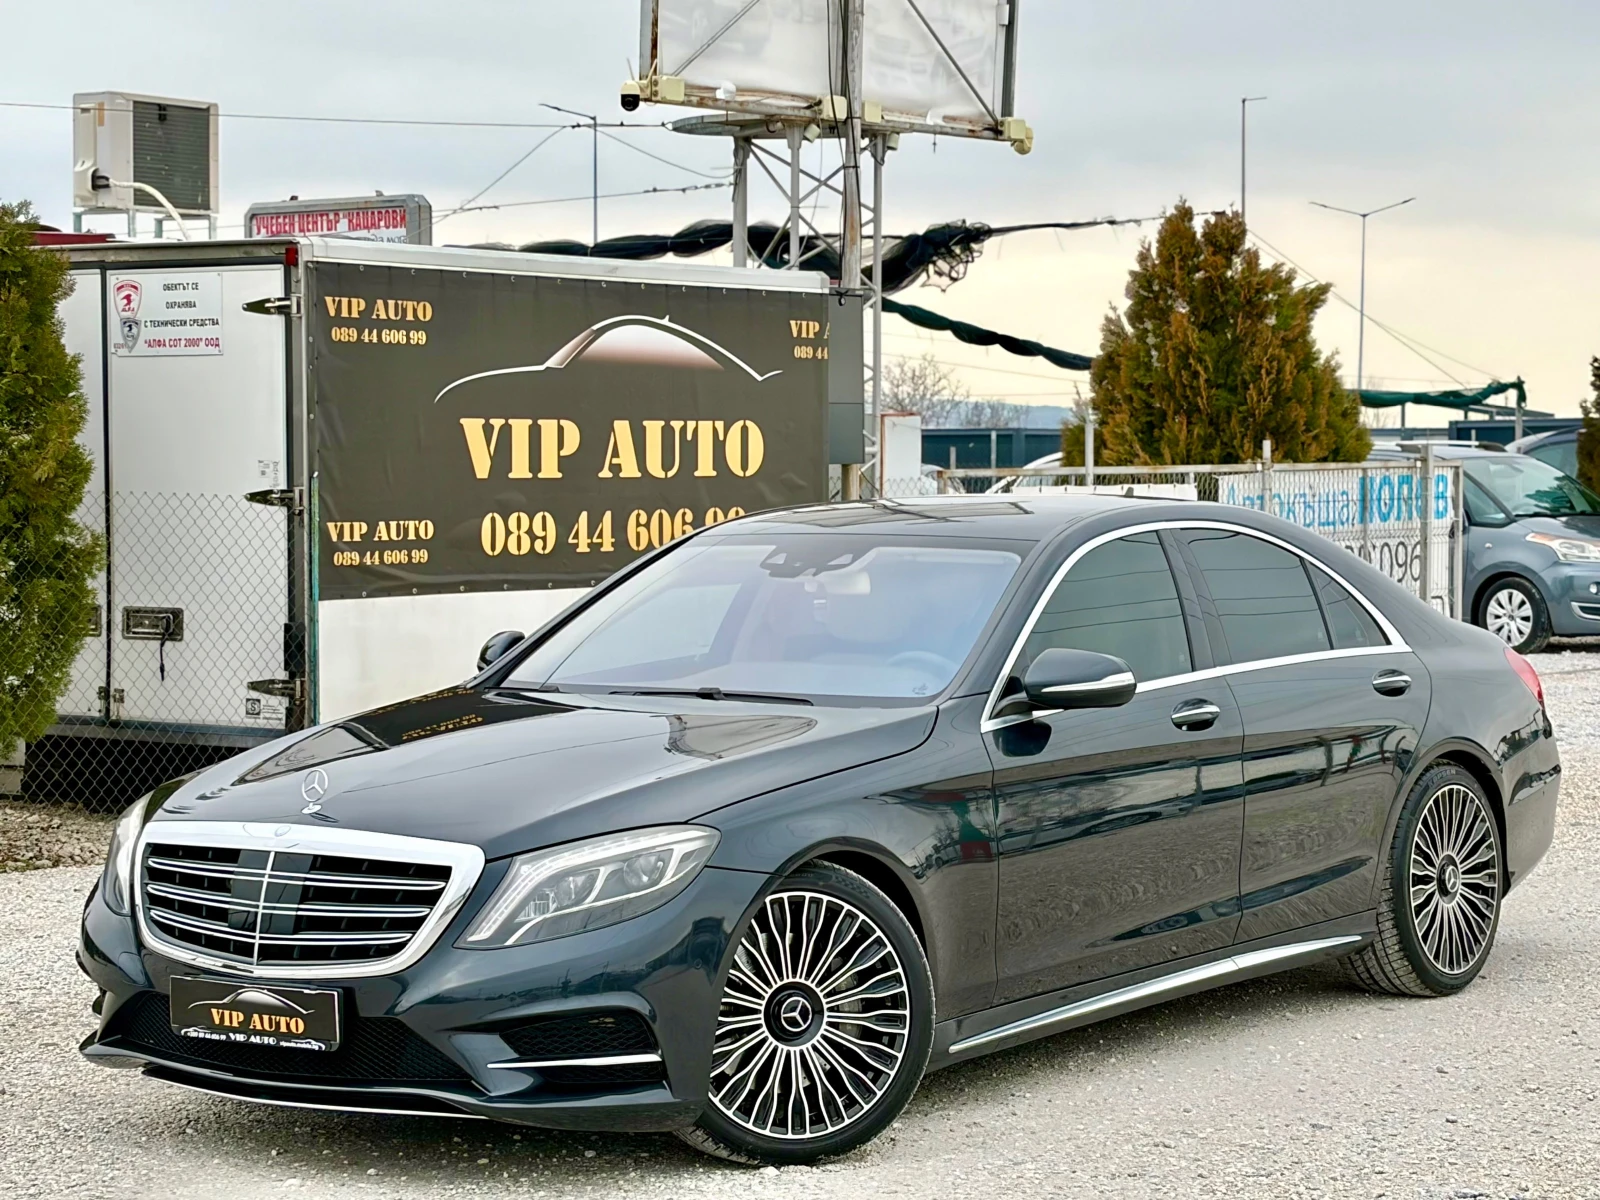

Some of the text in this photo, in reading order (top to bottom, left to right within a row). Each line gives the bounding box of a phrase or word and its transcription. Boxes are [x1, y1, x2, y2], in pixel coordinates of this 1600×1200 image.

[255, 212, 296, 236] УЧЕБЕН
[298, 211, 341, 236] ЦЕНТЪР
[162, 282, 200, 292] ОБЕКТЪТ СЕ
[165, 300, 197, 310] ОХРАНЯВА
[324, 296, 433, 322] VIP AUTO
[143, 318, 220, 329] С ТЕХНИЧЕСКИ СРЕДСТВА
[789, 319, 820, 339] VIP
[168, 338, 182, 348] СОТ
[204, 337, 220, 349] ООД
[331, 326, 427, 346] 089 44 606 99
[793, 345, 829, 361] 089 44
[459, 417, 765, 479] VIP AUTO
[326, 519, 435, 542] VIP AUTO
[480, 510, 557, 556] 089
[567, 509, 616, 553] 44
[626, 507, 694, 552] 606
[333, 548, 429, 566] 089 44 606 99
[210, 1008, 305, 1034] VIP AUTO
[228, 1032, 248, 1042] VIP
[249, 1035, 277, 1046] AUTO
